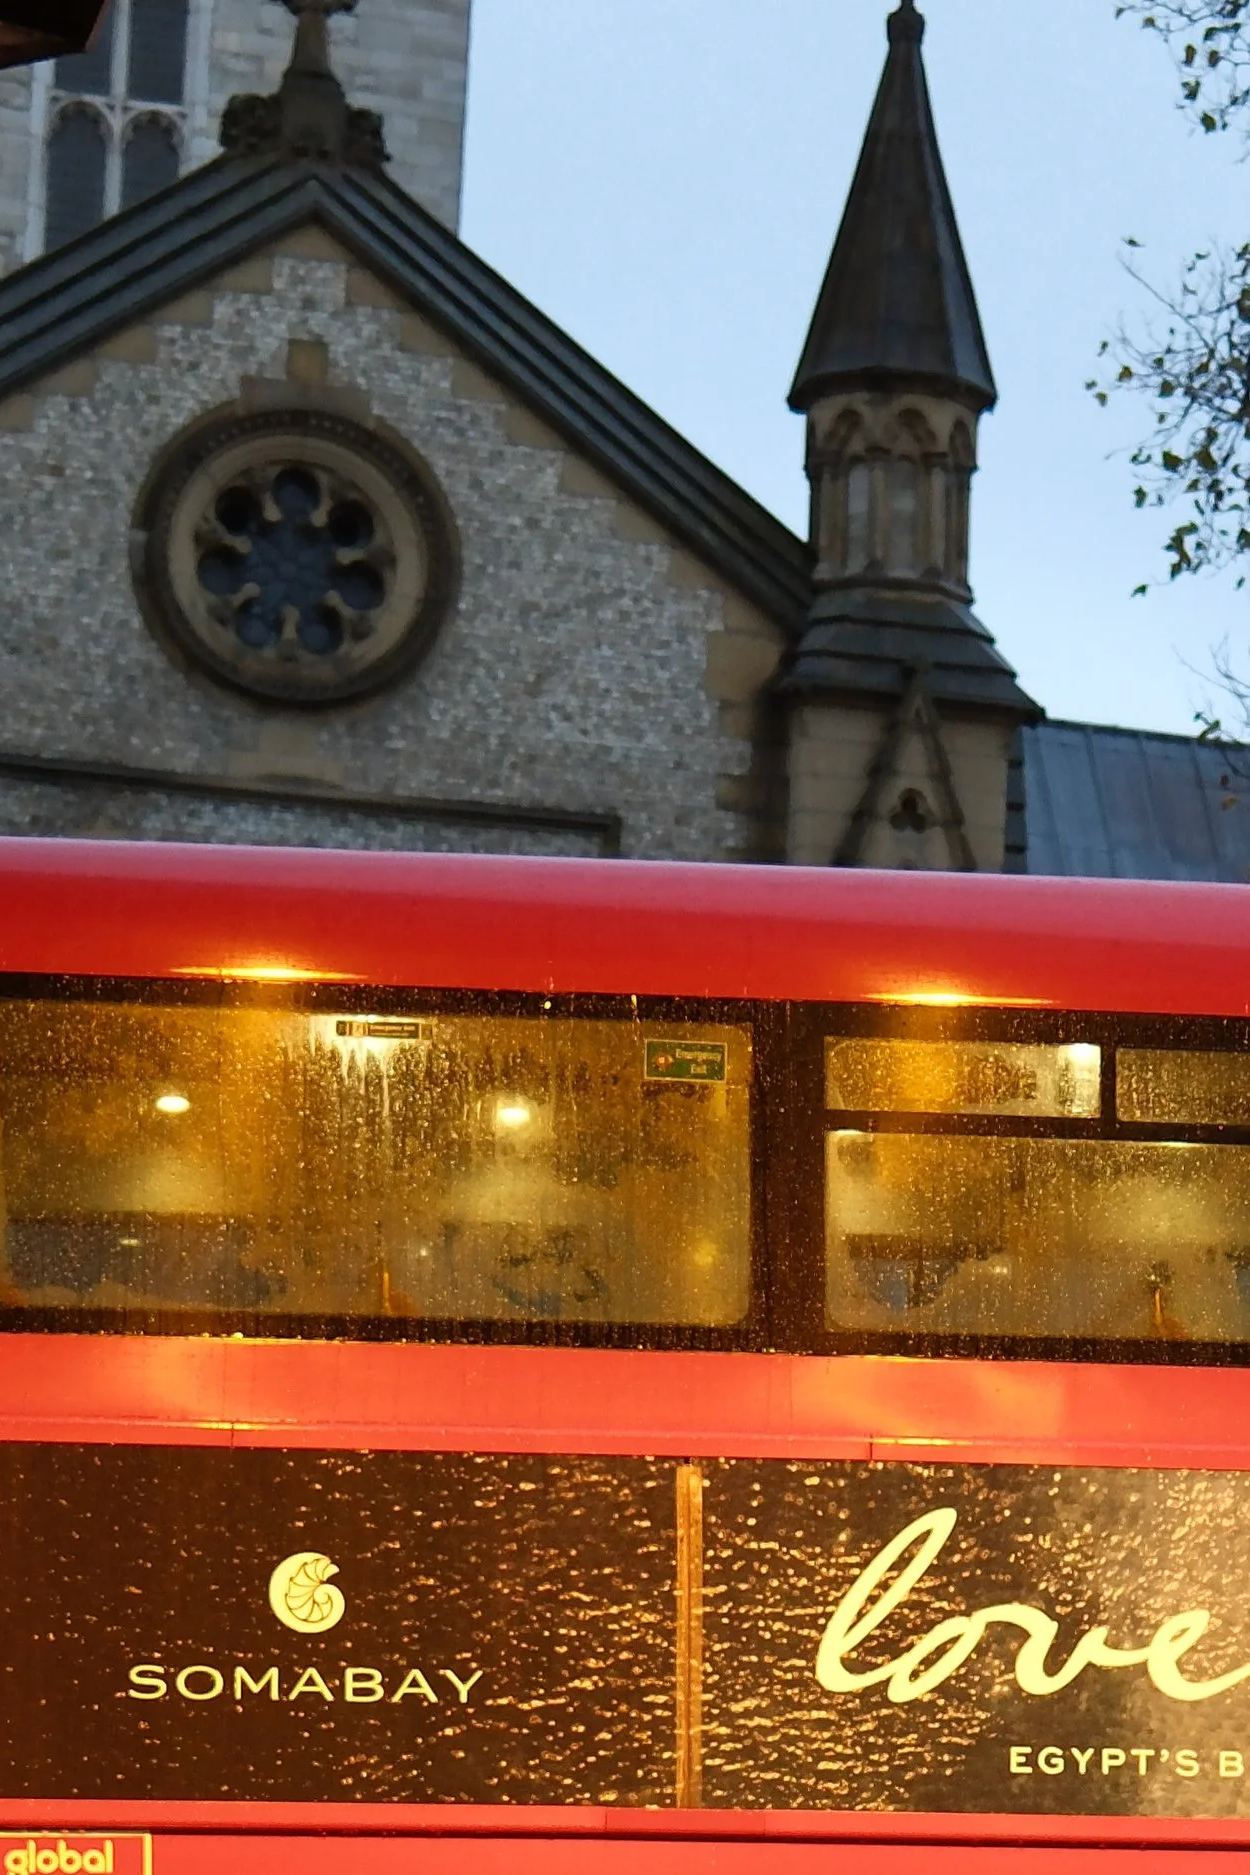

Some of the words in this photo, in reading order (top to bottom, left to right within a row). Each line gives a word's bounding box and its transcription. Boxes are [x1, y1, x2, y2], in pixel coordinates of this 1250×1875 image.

[815, 1507, 1250, 1703] love
[128, 1664, 484, 1704] SOMABAY
[1009, 1746, 1200, 1778] EGYPT'S
